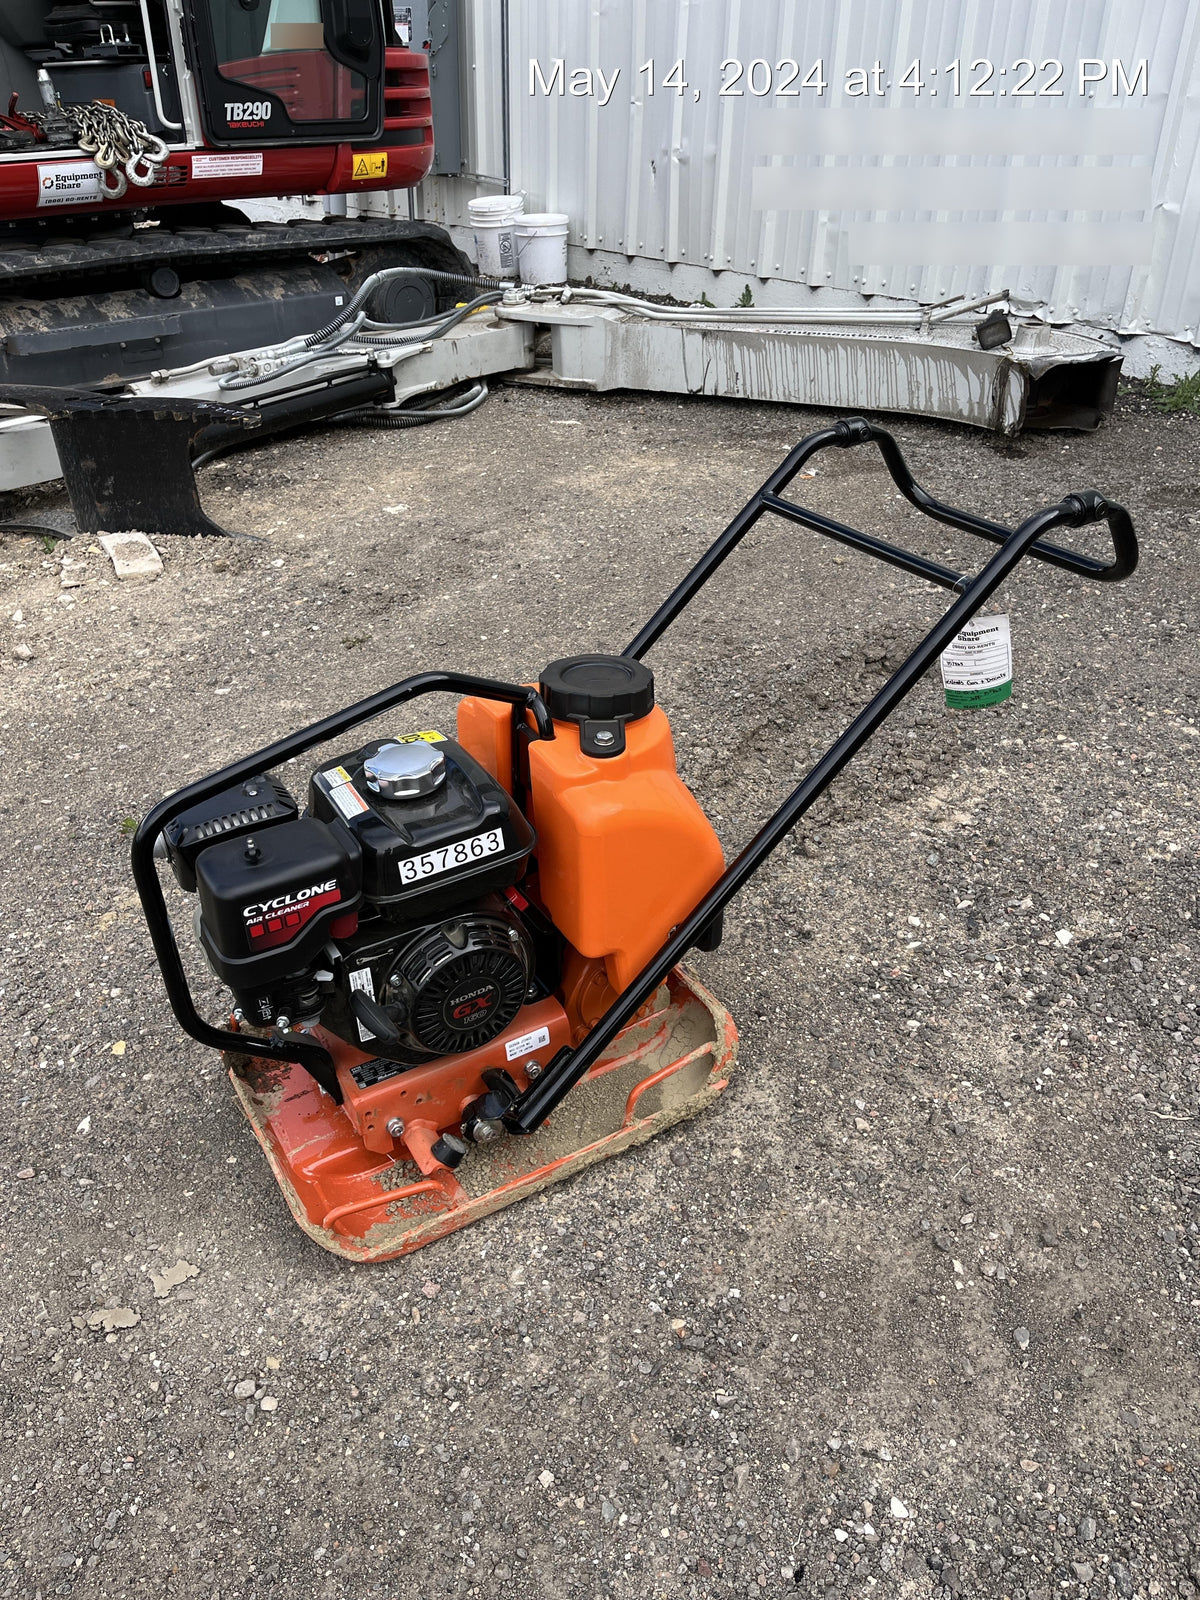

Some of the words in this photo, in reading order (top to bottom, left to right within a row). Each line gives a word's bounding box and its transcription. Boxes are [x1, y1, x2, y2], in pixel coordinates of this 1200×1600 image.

[224, 101, 272, 121] TB290
[55, 171, 103, 183] Equipment
[55, 182, 81, 190] Share
[957, 634, 980, 642] Share
[958, 626, 999, 637] quipment
[403, 832, 500, 881] 357863
[243, 879, 337, 917] CYCLONE
[246, 916, 263, 926] AIR
[265, 901, 310, 920] CLEANER
[450, 984, 494, 1006] HONDA
[452, 991, 493, 1019] GX
